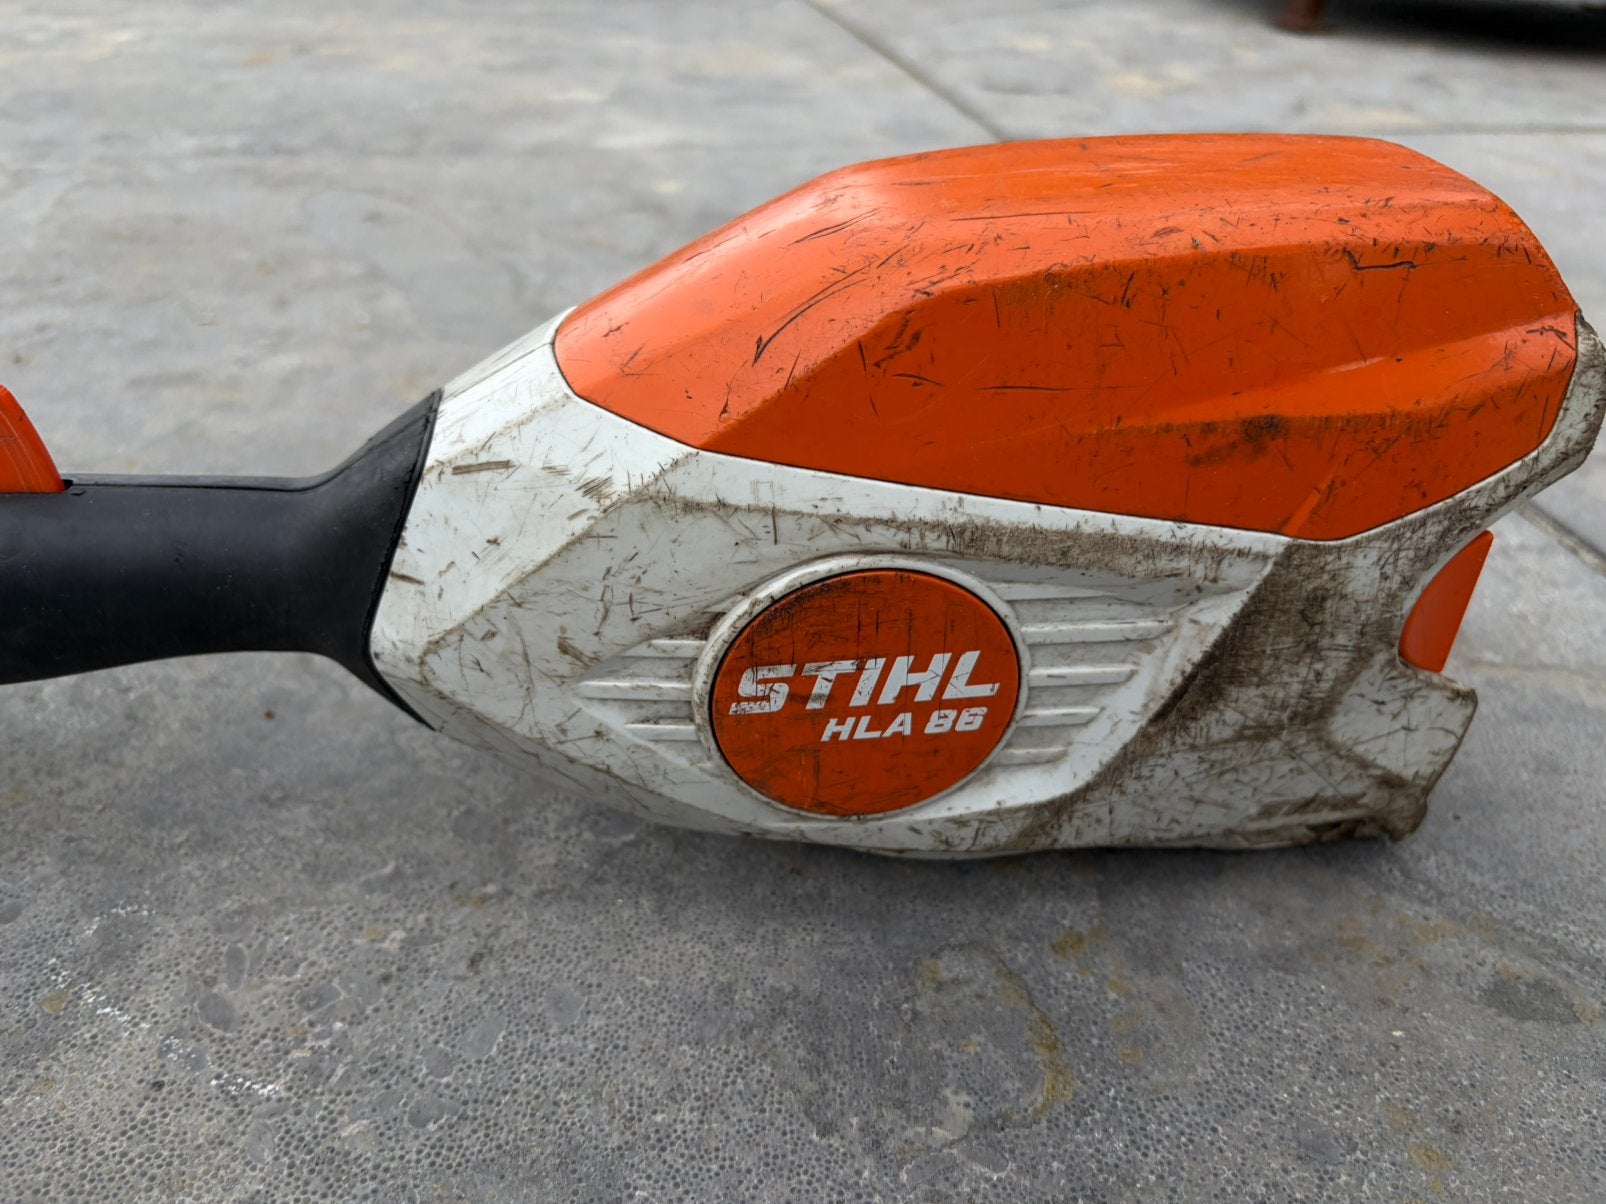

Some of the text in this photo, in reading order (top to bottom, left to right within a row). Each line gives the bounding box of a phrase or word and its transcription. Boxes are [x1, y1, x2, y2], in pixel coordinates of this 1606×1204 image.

[729, 650, 1000, 715] STIHL
[820, 706, 988, 741] HLA 86
